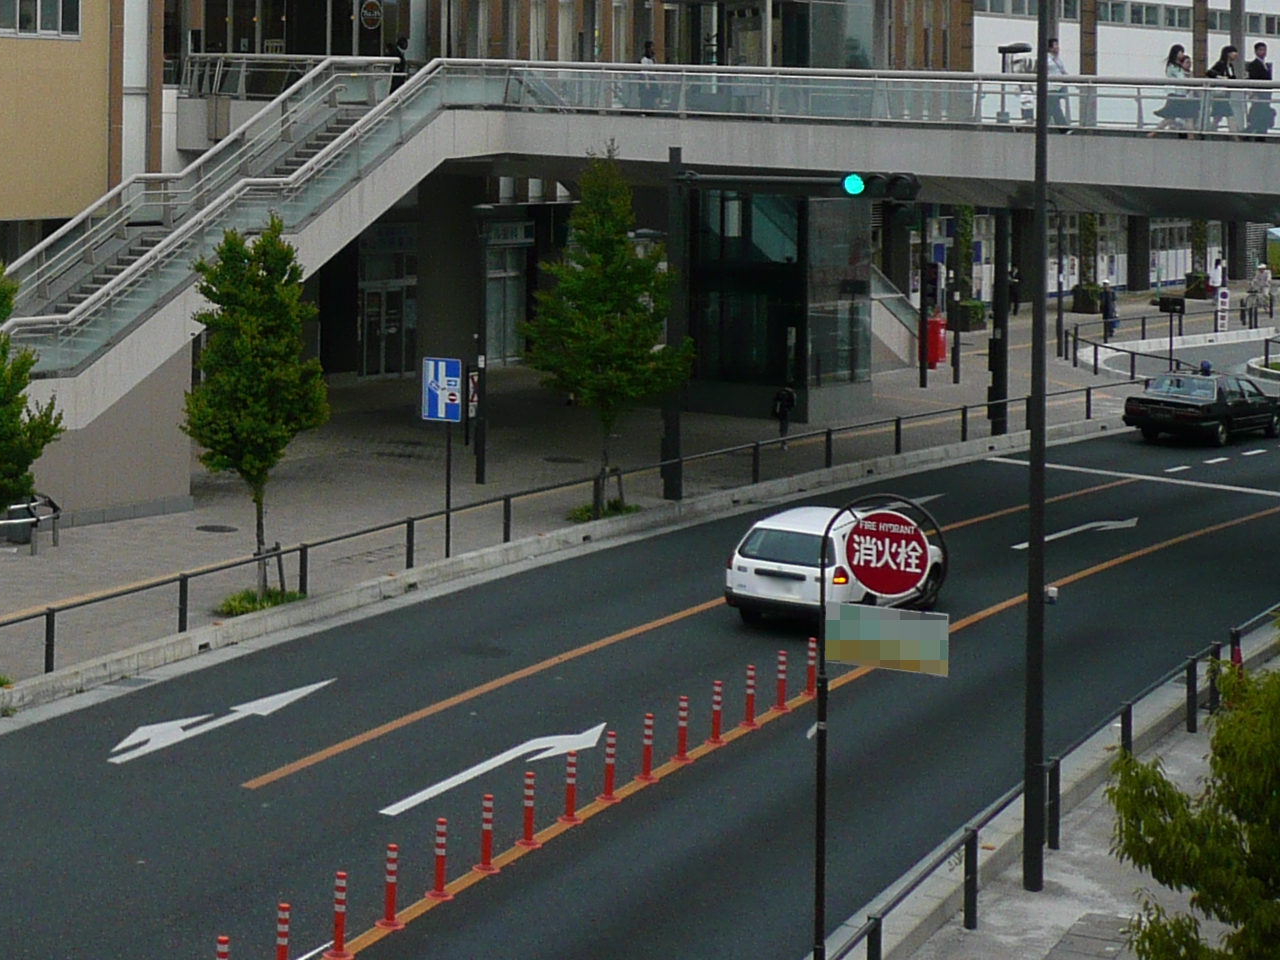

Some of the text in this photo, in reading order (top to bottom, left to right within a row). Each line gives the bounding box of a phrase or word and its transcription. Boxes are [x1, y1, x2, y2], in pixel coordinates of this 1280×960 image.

[860, 520, 915, 534] FIRE HYDRANT
[852, 534, 923, 573] 消火栓
